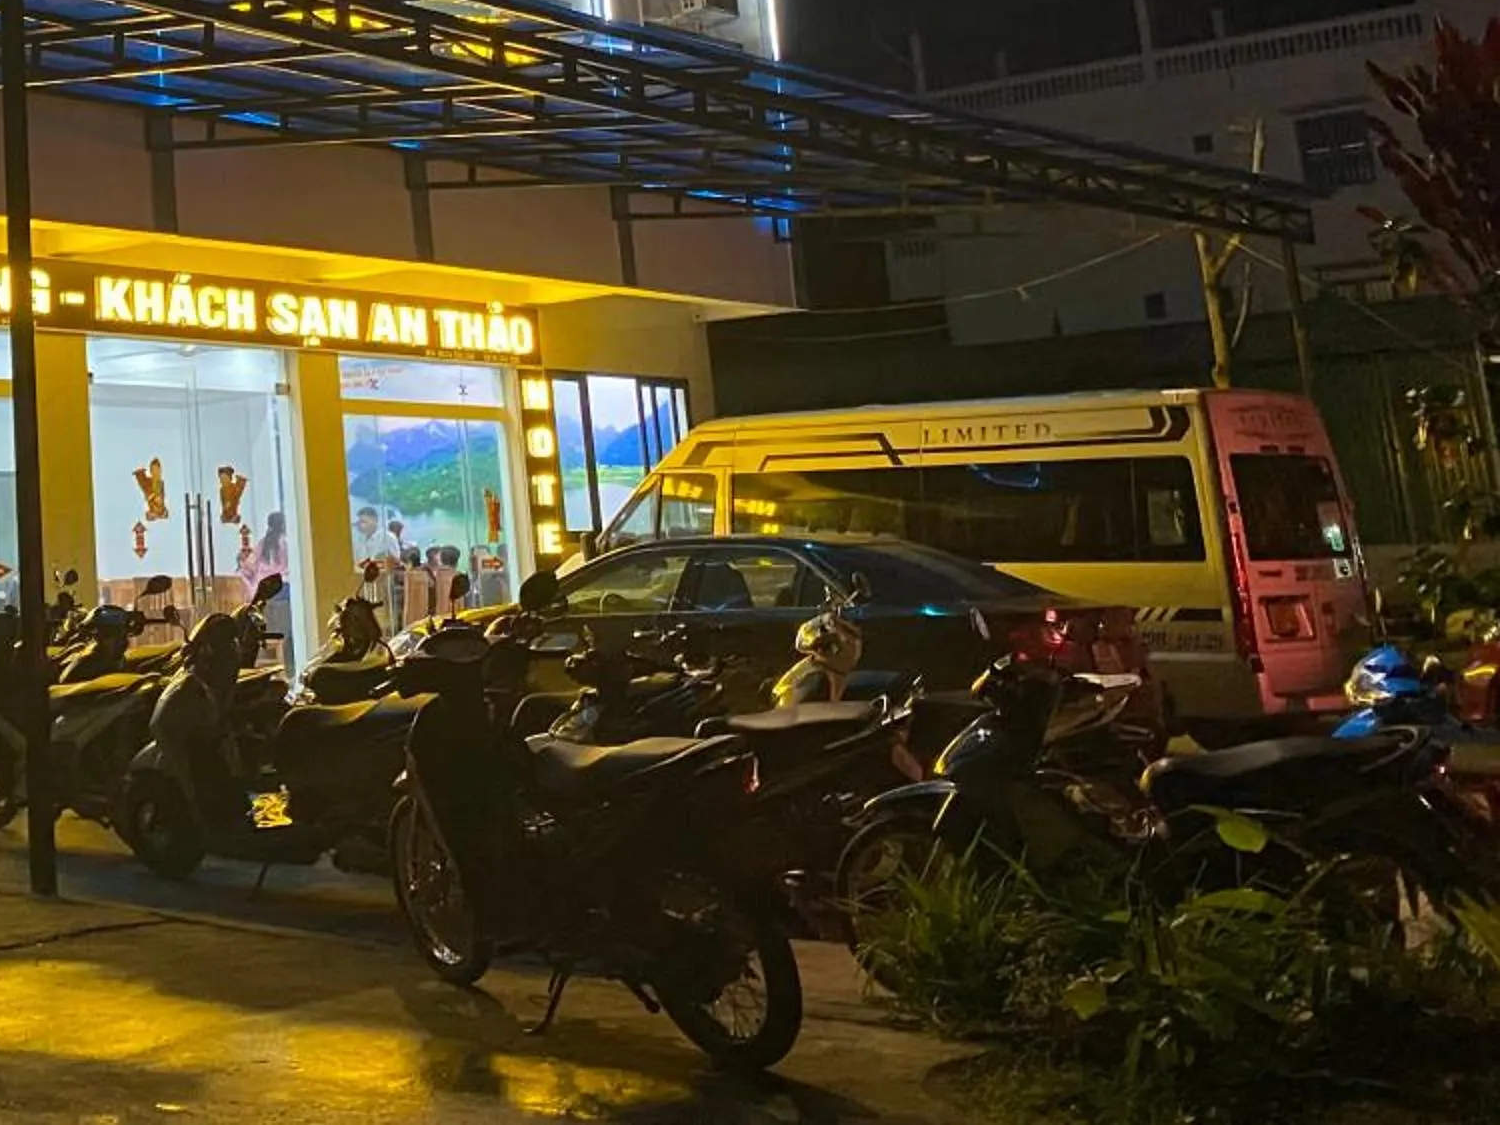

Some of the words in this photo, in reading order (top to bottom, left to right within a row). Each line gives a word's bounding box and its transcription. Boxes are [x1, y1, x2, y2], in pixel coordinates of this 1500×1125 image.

[94, 272, 257, 332] KHÁCH
[266, 292, 360, 347] SẠN
[366, 302, 429, 347] AN
[433, 300, 534, 355] THẢO
[922, 421, 1052, 444] LIMITED
